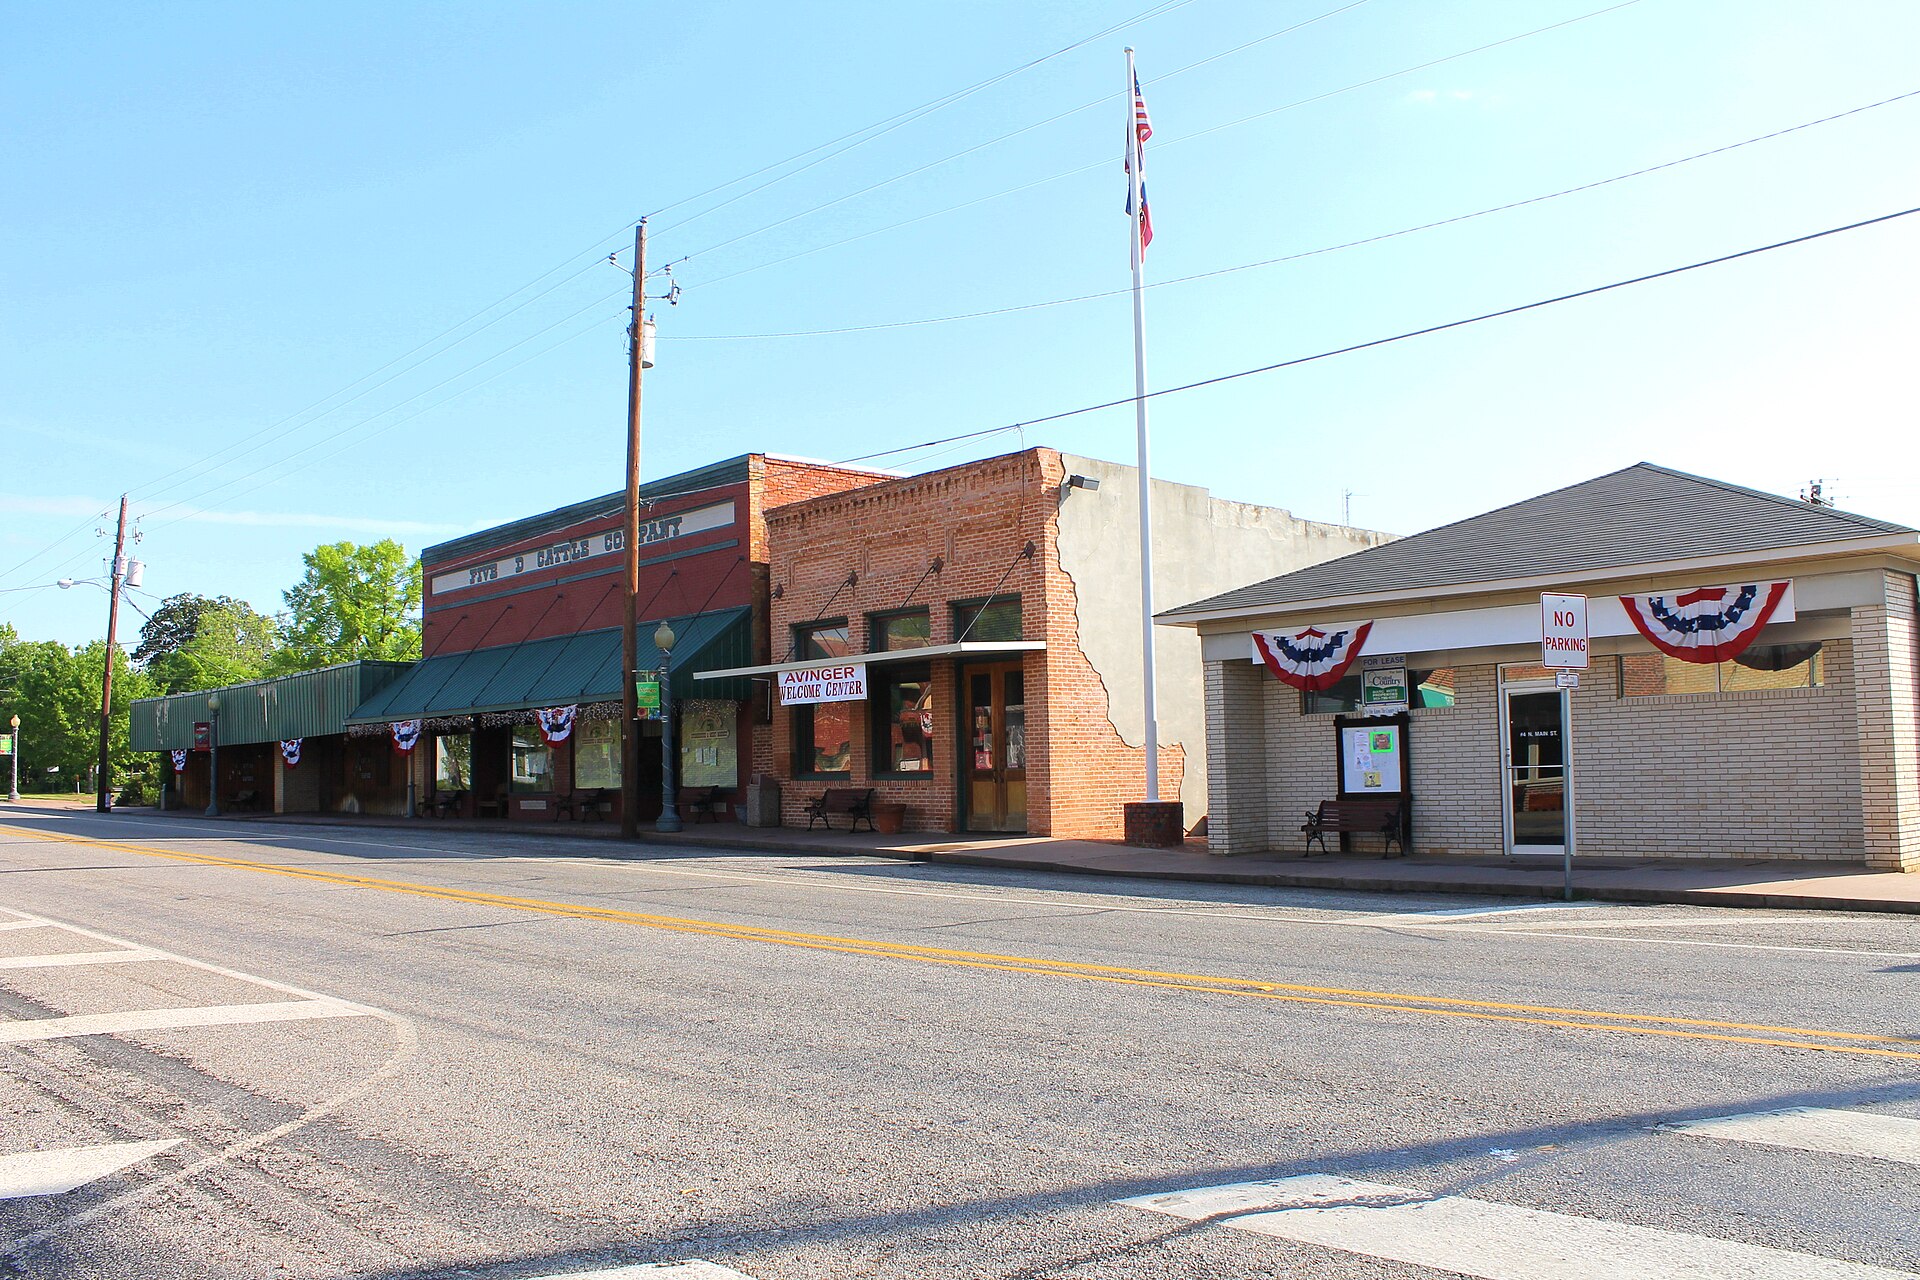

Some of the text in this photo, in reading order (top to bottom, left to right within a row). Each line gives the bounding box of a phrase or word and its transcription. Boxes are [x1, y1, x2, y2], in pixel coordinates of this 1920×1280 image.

[469, 516, 683, 585] FIVE D CATTLE COPANY
[1554, 611, 1575, 627] NO
[1545, 637, 1586, 652] PARKING
[1381, 656, 1405, 665] LEASE
[784, 666, 855, 684] AVINGER
[1372, 676, 1401, 686] Country
[779, 680, 864, 701] WELCOME CENTER
